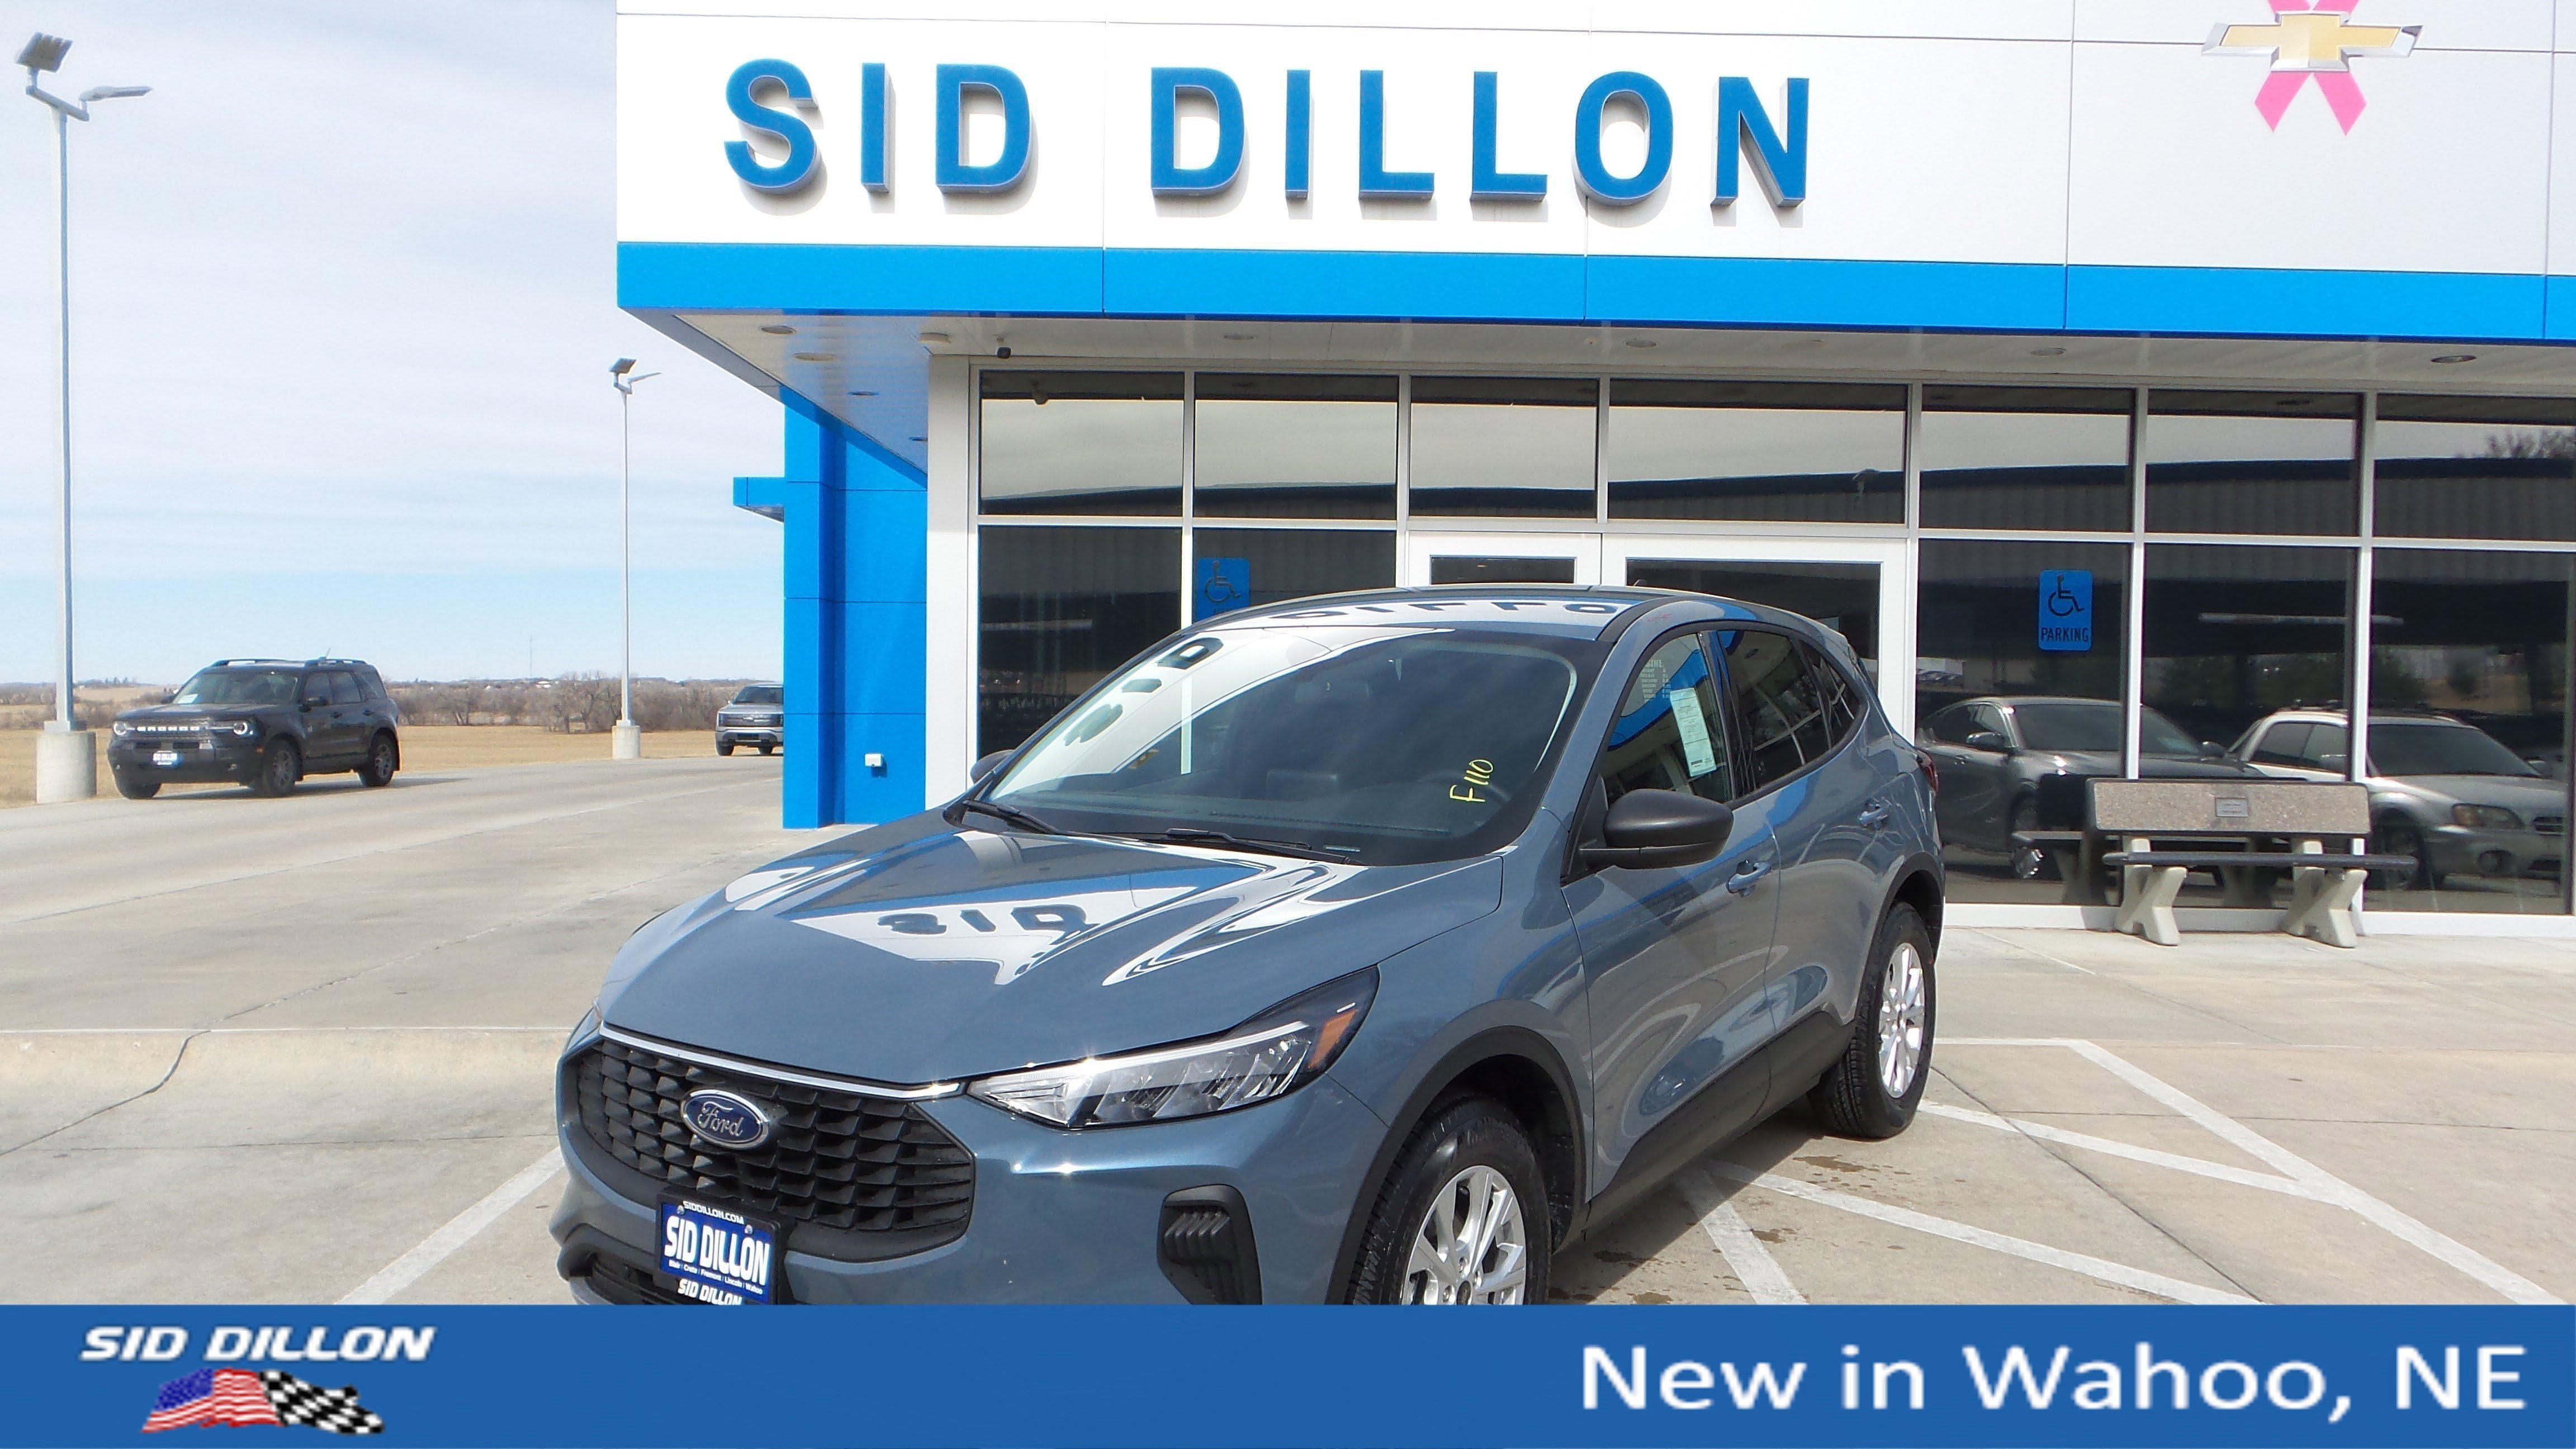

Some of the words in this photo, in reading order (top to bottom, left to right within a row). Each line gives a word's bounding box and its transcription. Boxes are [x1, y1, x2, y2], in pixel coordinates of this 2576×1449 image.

[723, 58, 1034, 191] SID
[1150, 67, 1810, 206] DILLON
[2040, 627, 2090, 642] PARKING
[1449, 759, 1494, 803] F110
[697, 1100, 745, 1137] Ford
[683, 1200, 745, 1225] SIDDILLON.COM
[664, 1215, 697, 1263] SID
[699, 1224, 770, 1286] DILLON
[678, 1278, 699, 1298] SID
[699, 1284, 743, 1305] DILLON
